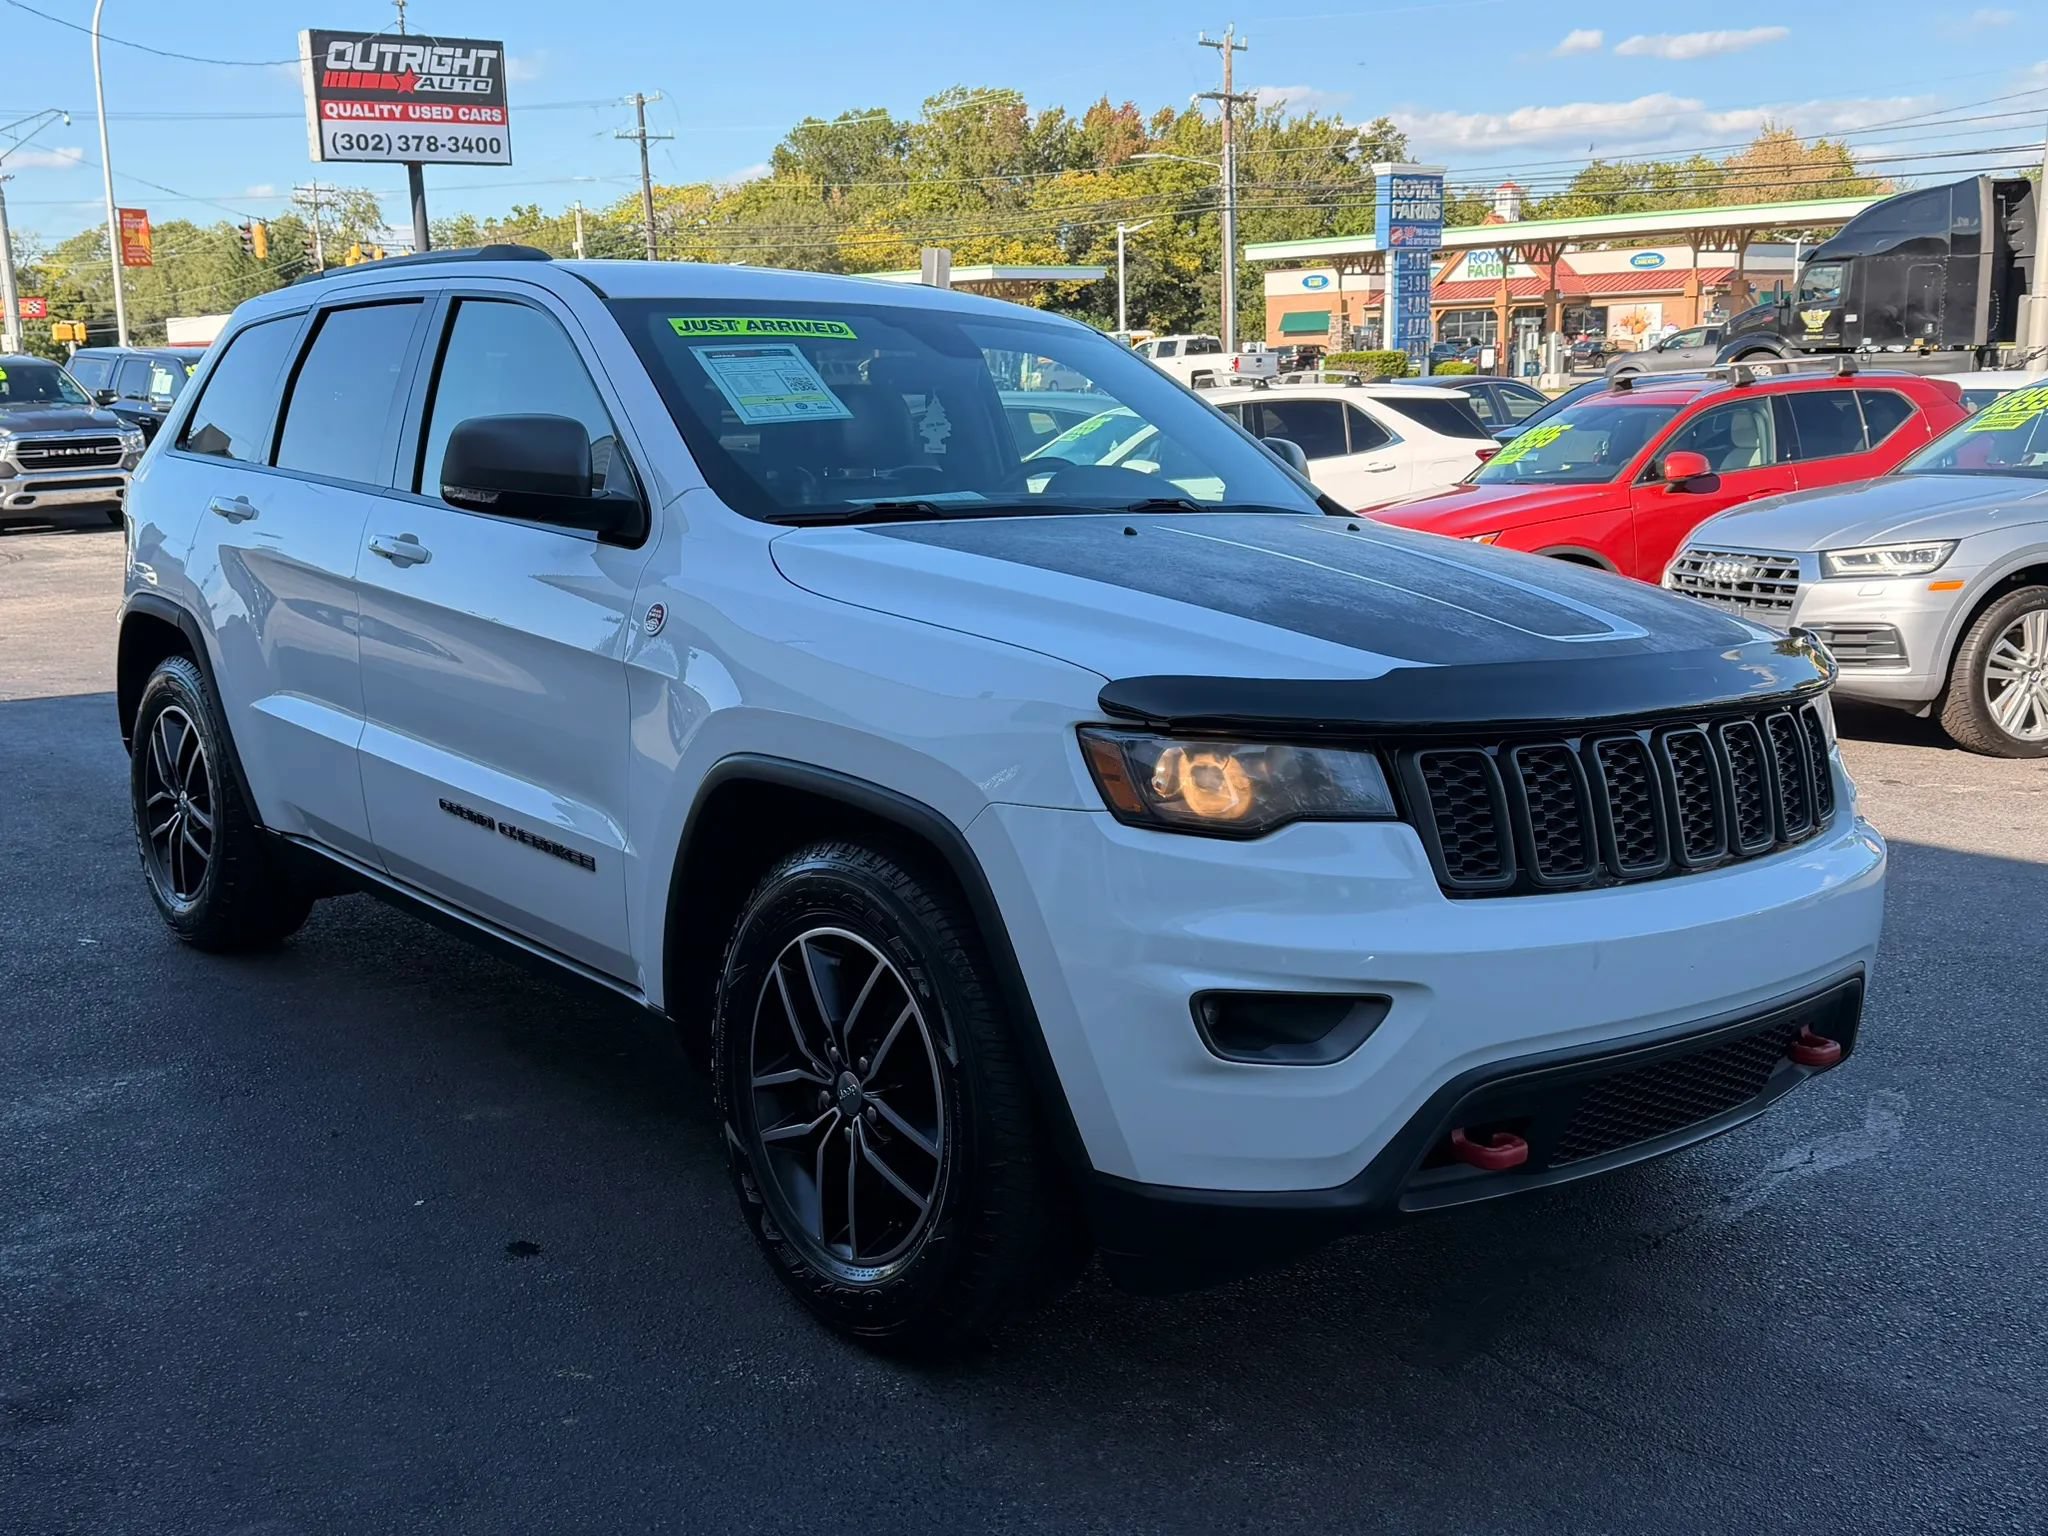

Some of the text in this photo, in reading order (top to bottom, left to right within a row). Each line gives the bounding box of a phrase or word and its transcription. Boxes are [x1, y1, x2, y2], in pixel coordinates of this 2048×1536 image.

[326, 40, 498, 77] OUTRIGHT
[419, 77, 490, 92] AUTO
[324, 102, 502, 122] QUALITY USED CARS
[332, 132, 501, 156] (302) 378-3400
[1392, 178, 1441, 199] ROYAL
[1391, 199, 1441, 220] FARMS
[678, 319, 851, 336] JUST ARRIVED
[49, 447, 95, 457] RAM
